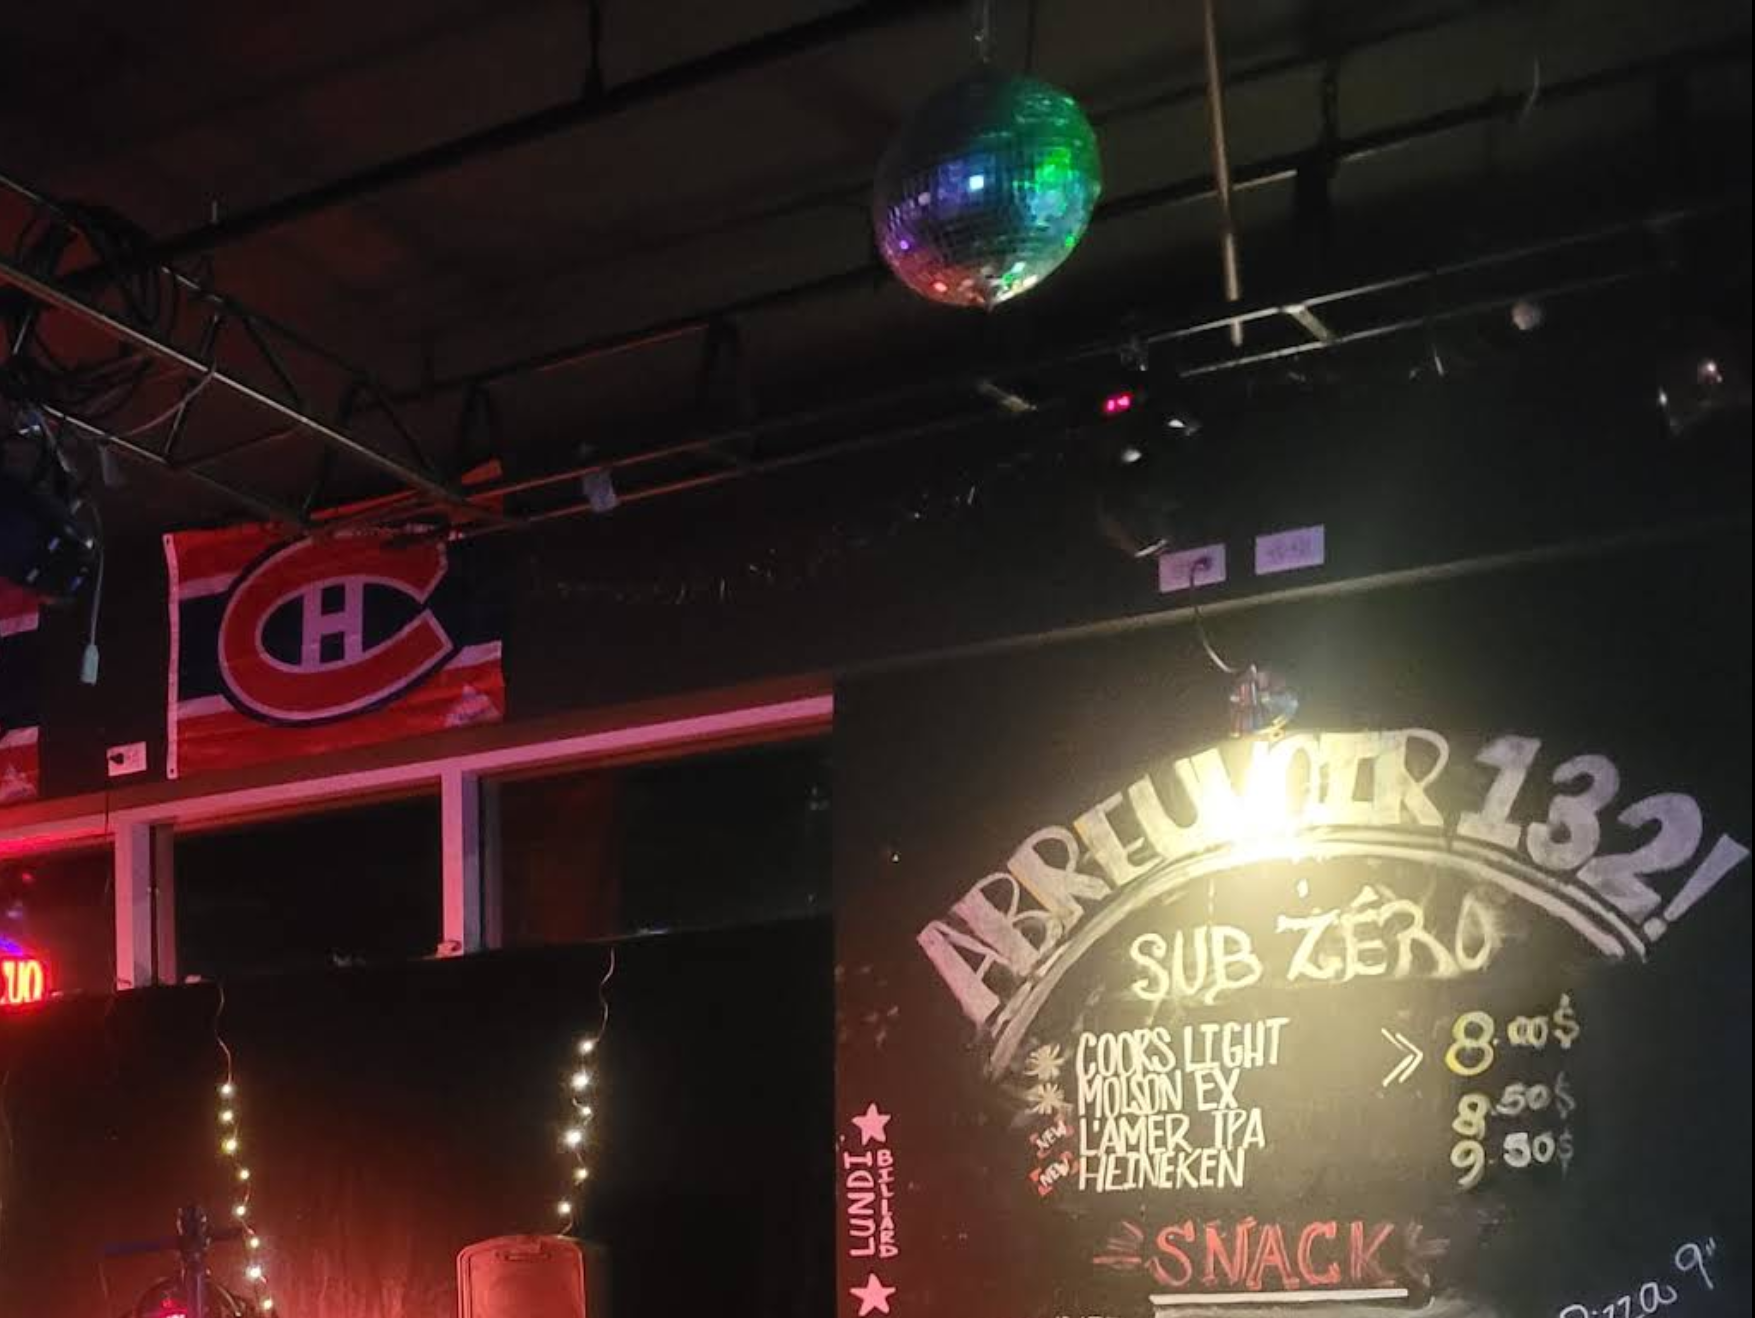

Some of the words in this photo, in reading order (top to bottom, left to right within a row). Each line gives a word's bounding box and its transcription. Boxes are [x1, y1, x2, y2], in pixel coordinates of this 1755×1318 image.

[916, 728, 1449, 1024] ABREUVOIR
[1452, 734, 1750, 942] 132!
[1129, 924, 1264, 1003] SUB
[1076, 1028, 1176, 1076] COORS
[1184, 1018, 1290, 1071] LIGHT
[1078, 1071, 1181, 1118] MOLSON
[1196, 1069, 1240, 1111] EX
[1036, 1119, 1067, 1149] NEW
[1079, 1113, 1191, 1156] L'AMER
[1211, 1108, 1266, 1150] IPA
[1039, 1157, 1070, 1188] NEW
[1079, 1147, 1245, 1192] HEINEKEN
[844, 1151, 875, 1257] LUNDI
[878, 1149, 898, 1258] BILLARD
[1146, 1215, 1396, 1290] SNACK
